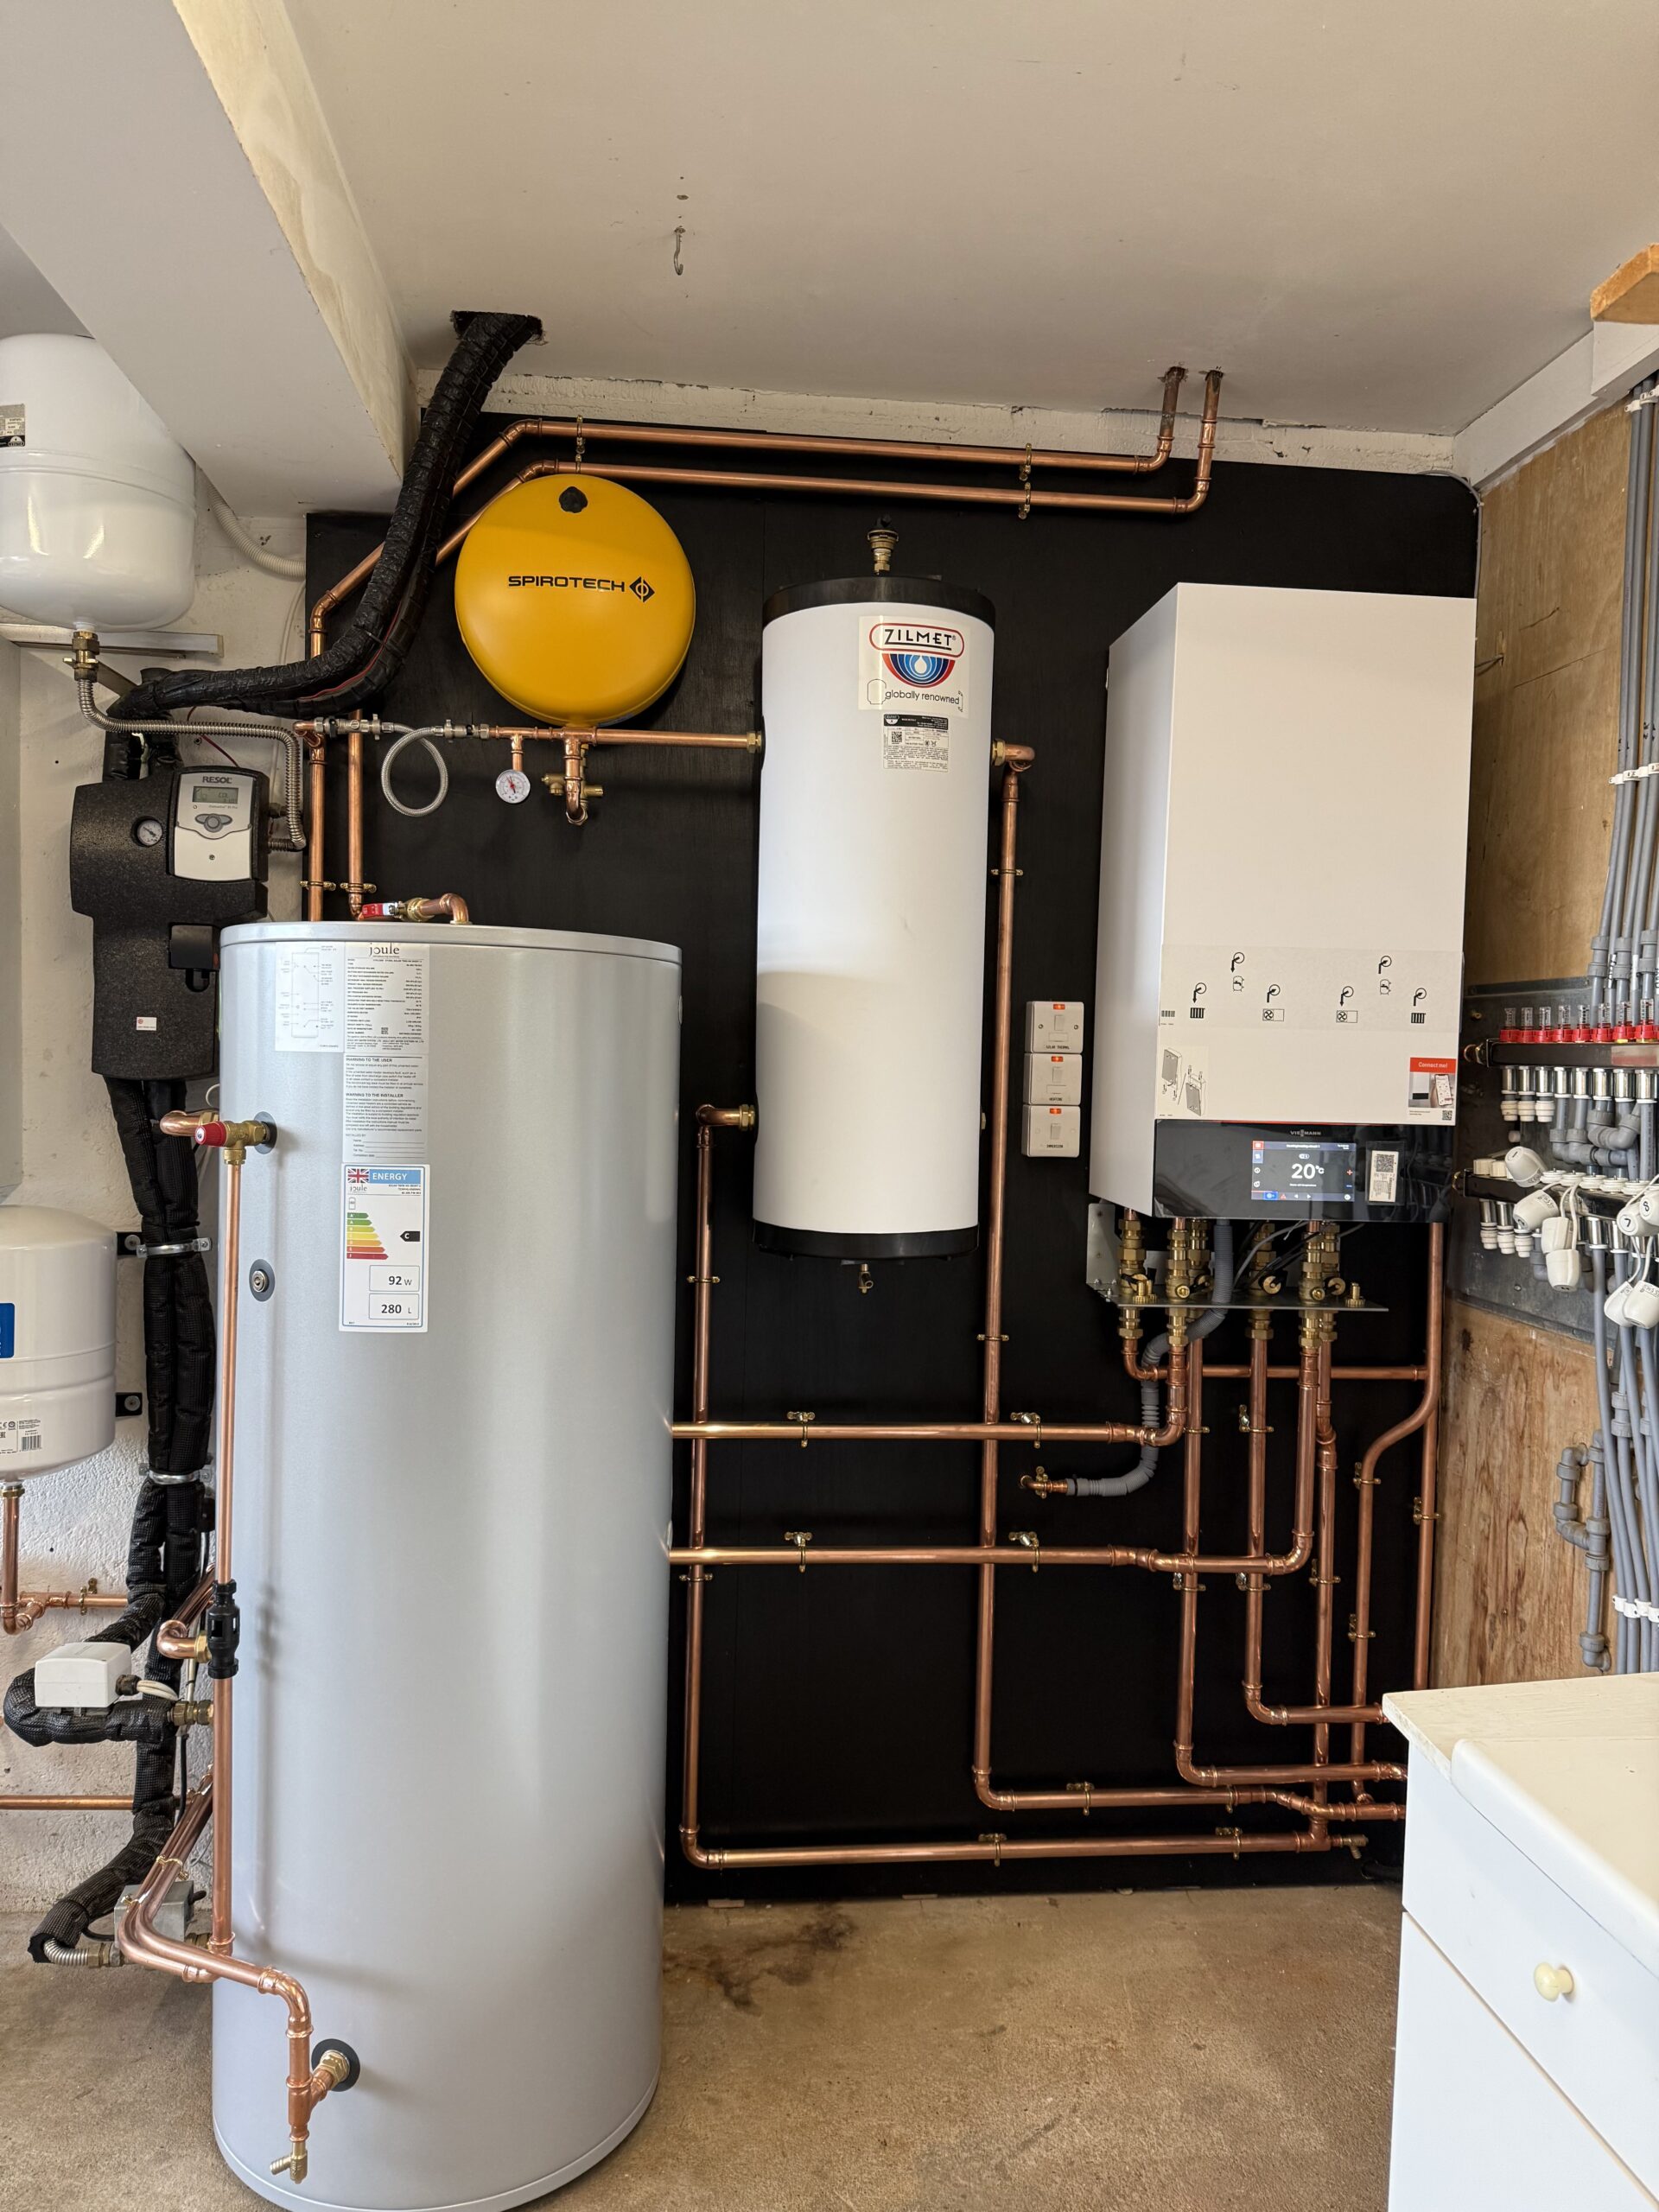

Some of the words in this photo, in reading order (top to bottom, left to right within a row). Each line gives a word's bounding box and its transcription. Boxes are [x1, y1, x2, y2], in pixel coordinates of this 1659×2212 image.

[508, 575, 625, 592] SPIROTECH
[884, 629, 952, 650] ZILMET
[885, 690, 920, 701] globally
[921, 692, 960, 705] renowned
[369, 942, 400, 957] joule
[388, 1275, 402, 1285] 92
[381, 1304, 402, 1313] 280
